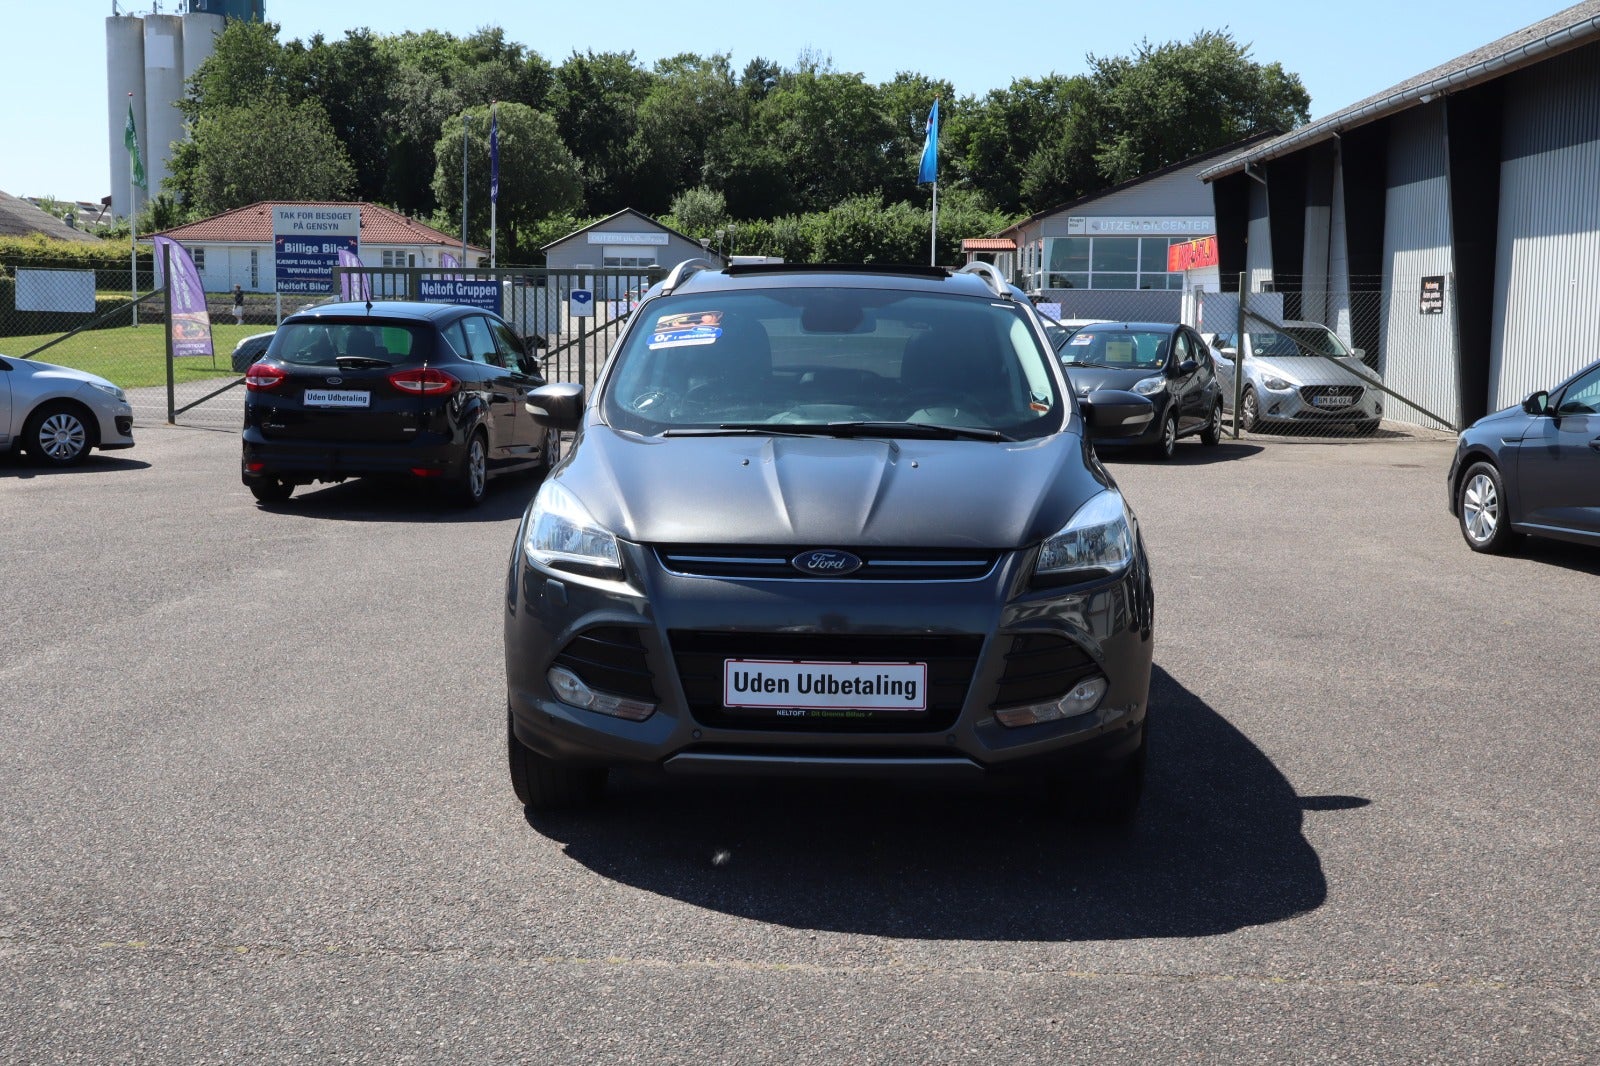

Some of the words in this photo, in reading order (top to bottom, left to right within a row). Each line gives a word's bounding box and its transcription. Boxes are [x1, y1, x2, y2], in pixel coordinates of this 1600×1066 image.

[280, 212, 295, 220] TAK
[297, 212, 313, 220] FOR
[316, 212, 352, 220] BESØGET
[293, 221, 304, 230] PÅ
[306, 222, 339, 231] GENSYN
[1143, 220, 1210, 231] BILCENTER
[284, 243, 319, 255] Billige
[287, 267, 333, 275] www.neltof
[277, 281, 308, 290] Neltoft
[309, 282, 330, 291] Biler
[421, 282, 454, 295] Neltoft
[456, 282, 498, 298] Gruppen
[307, 393, 326, 401] Uden
[327, 393, 368, 404] Udbetaling
[807, 552, 846, 570] Ford
[733, 671, 790, 694] Uden
[797, 673, 917, 701] Udbetaling
[776, 709, 806, 717] NELTOFT
